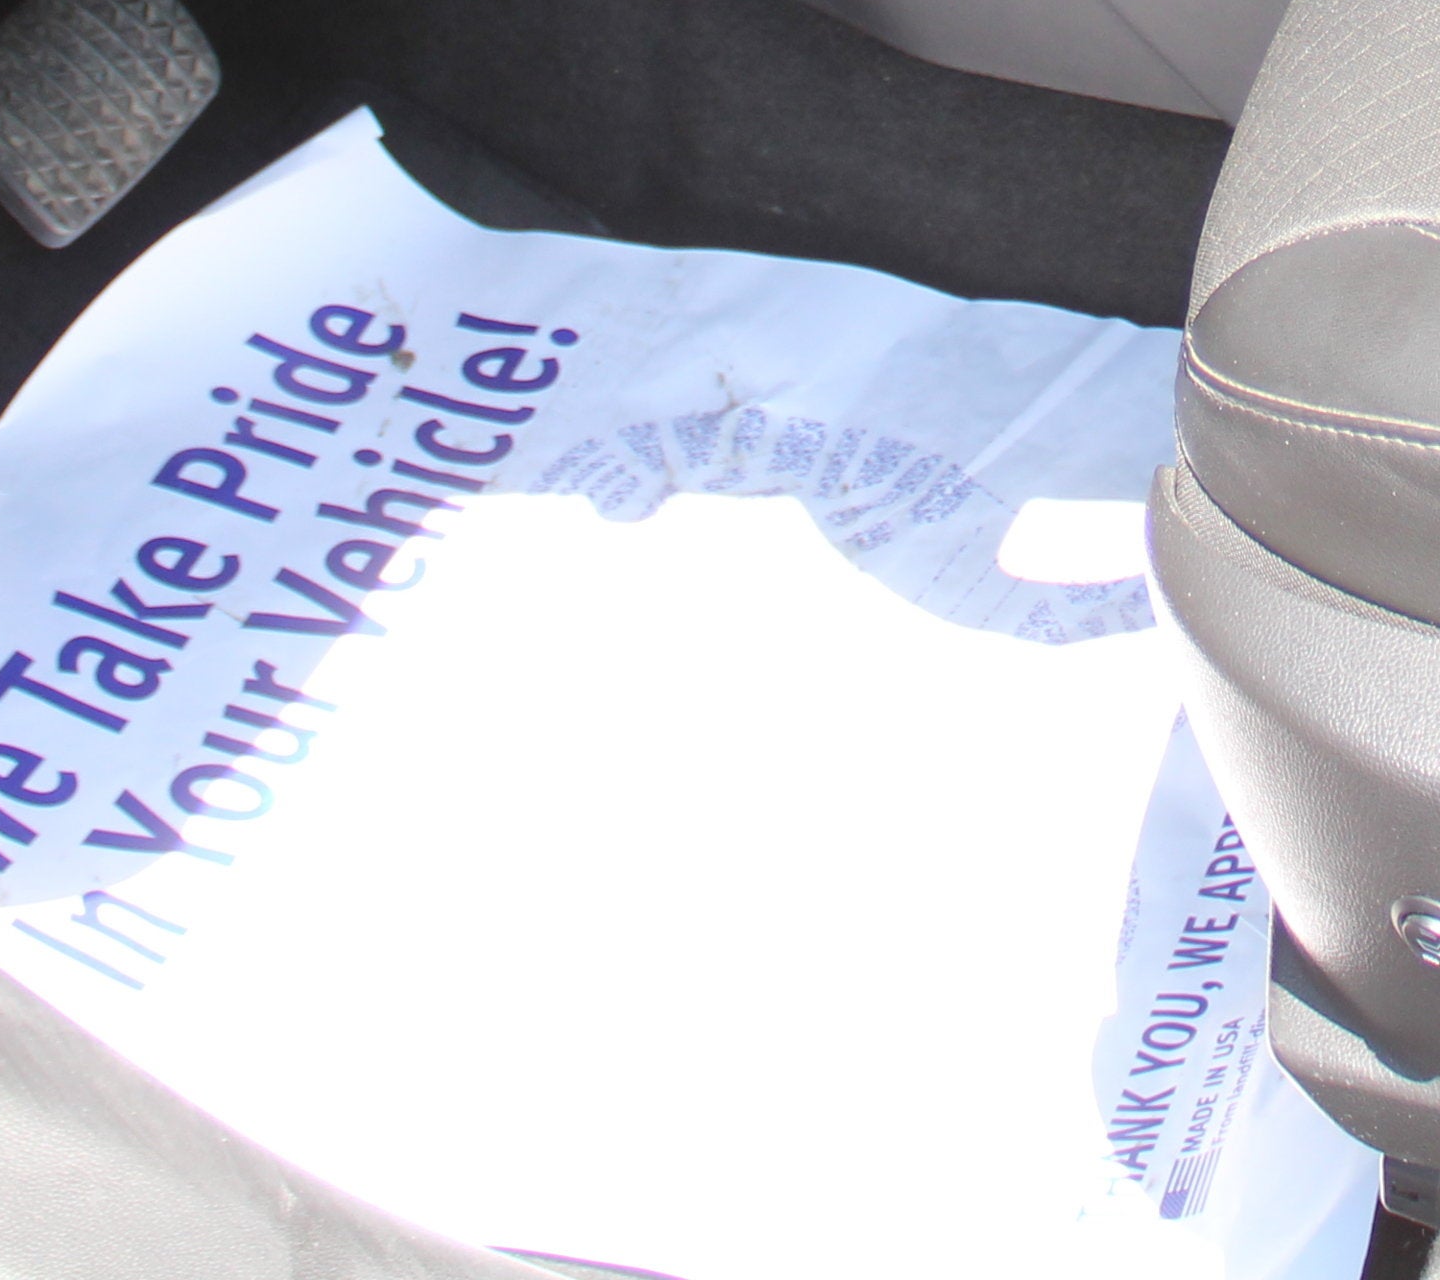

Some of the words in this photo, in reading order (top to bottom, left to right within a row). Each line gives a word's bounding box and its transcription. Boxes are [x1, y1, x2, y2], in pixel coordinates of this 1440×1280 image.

[149, 303, 407, 523] Pride
[241, 312, 579, 637] Vehicle!
[81, 659, 338, 867] Your
[1198, 812, 1256, 902] APP
[11, 889, 188, 992] In
[1167, 913, 1239, 970] WE
[1129, 981, 1224, 1076] YOU,
[1212, 1017, 1245, 1059] USA
[1203, 1065, 1228, 1088] IN
[1181, 1093, 1218, 1153] MADE
